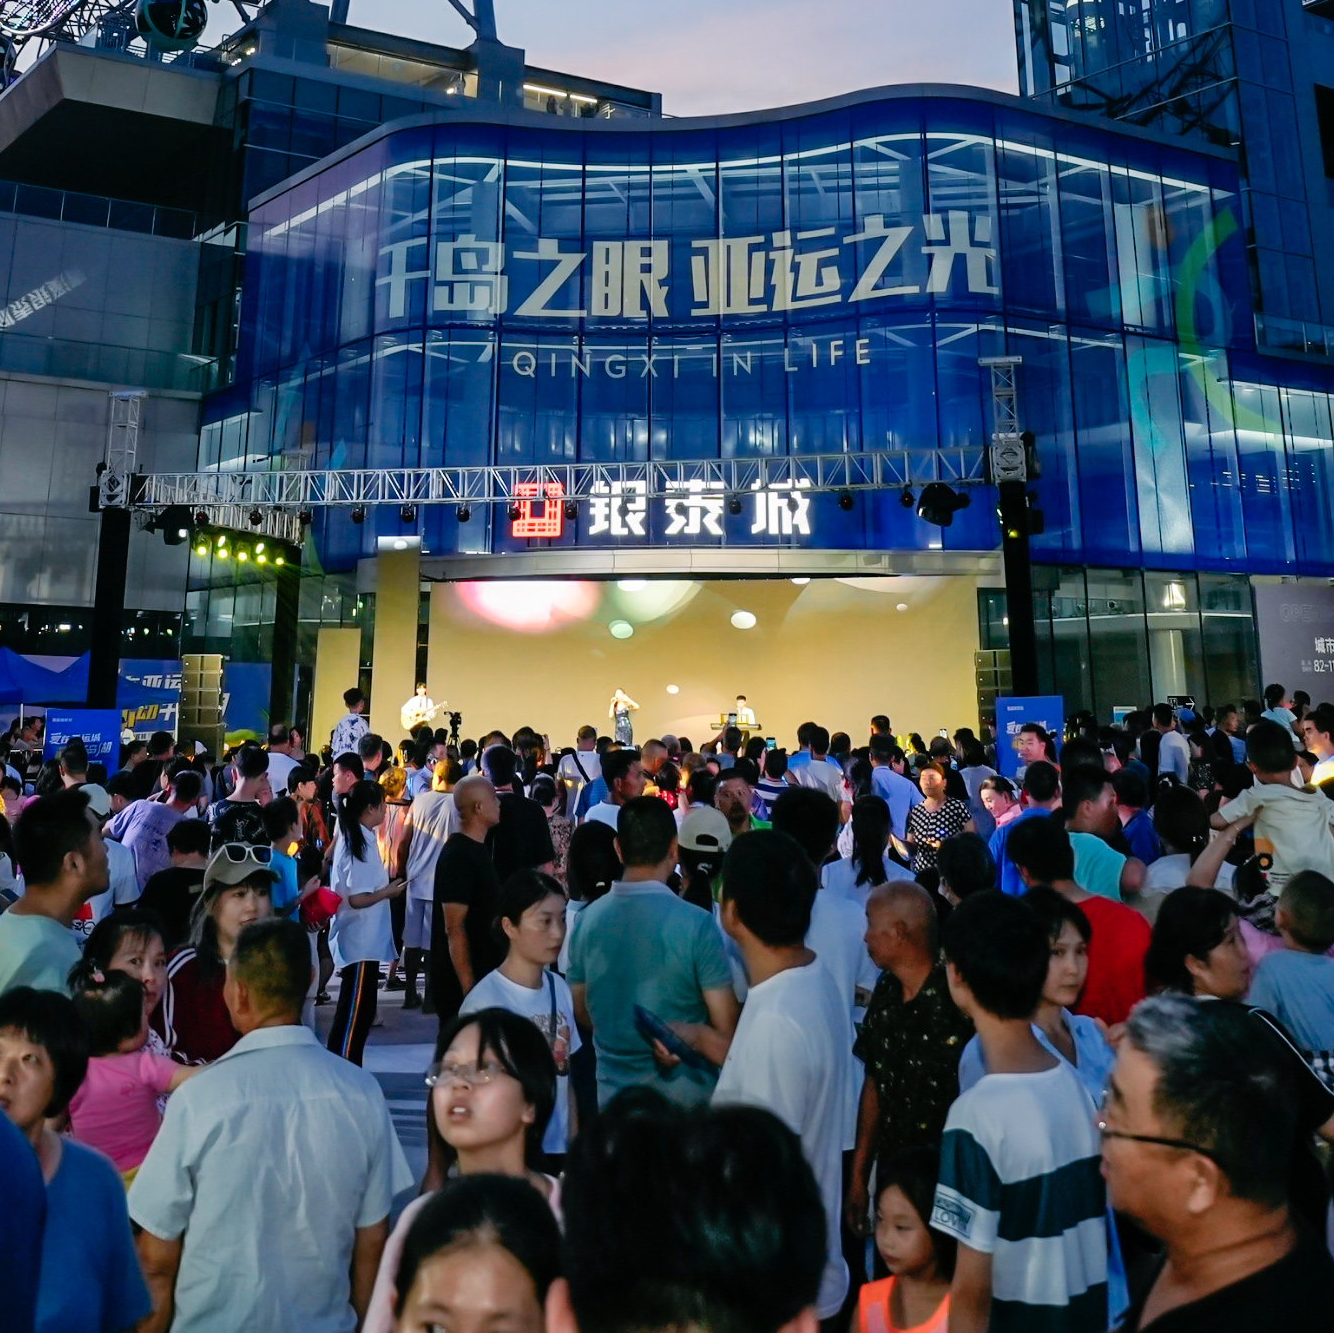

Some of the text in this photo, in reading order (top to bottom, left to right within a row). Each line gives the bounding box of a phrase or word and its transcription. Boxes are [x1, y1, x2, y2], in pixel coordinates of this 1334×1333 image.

[376, 211, 1000, 319] 千岛之眼 亚运之光
[512, 339, 871, 379] QINGXI IN LIFE
[589, 478, 811, 535] 银泰城
[49, 732, 101, 745] 爱在运城
